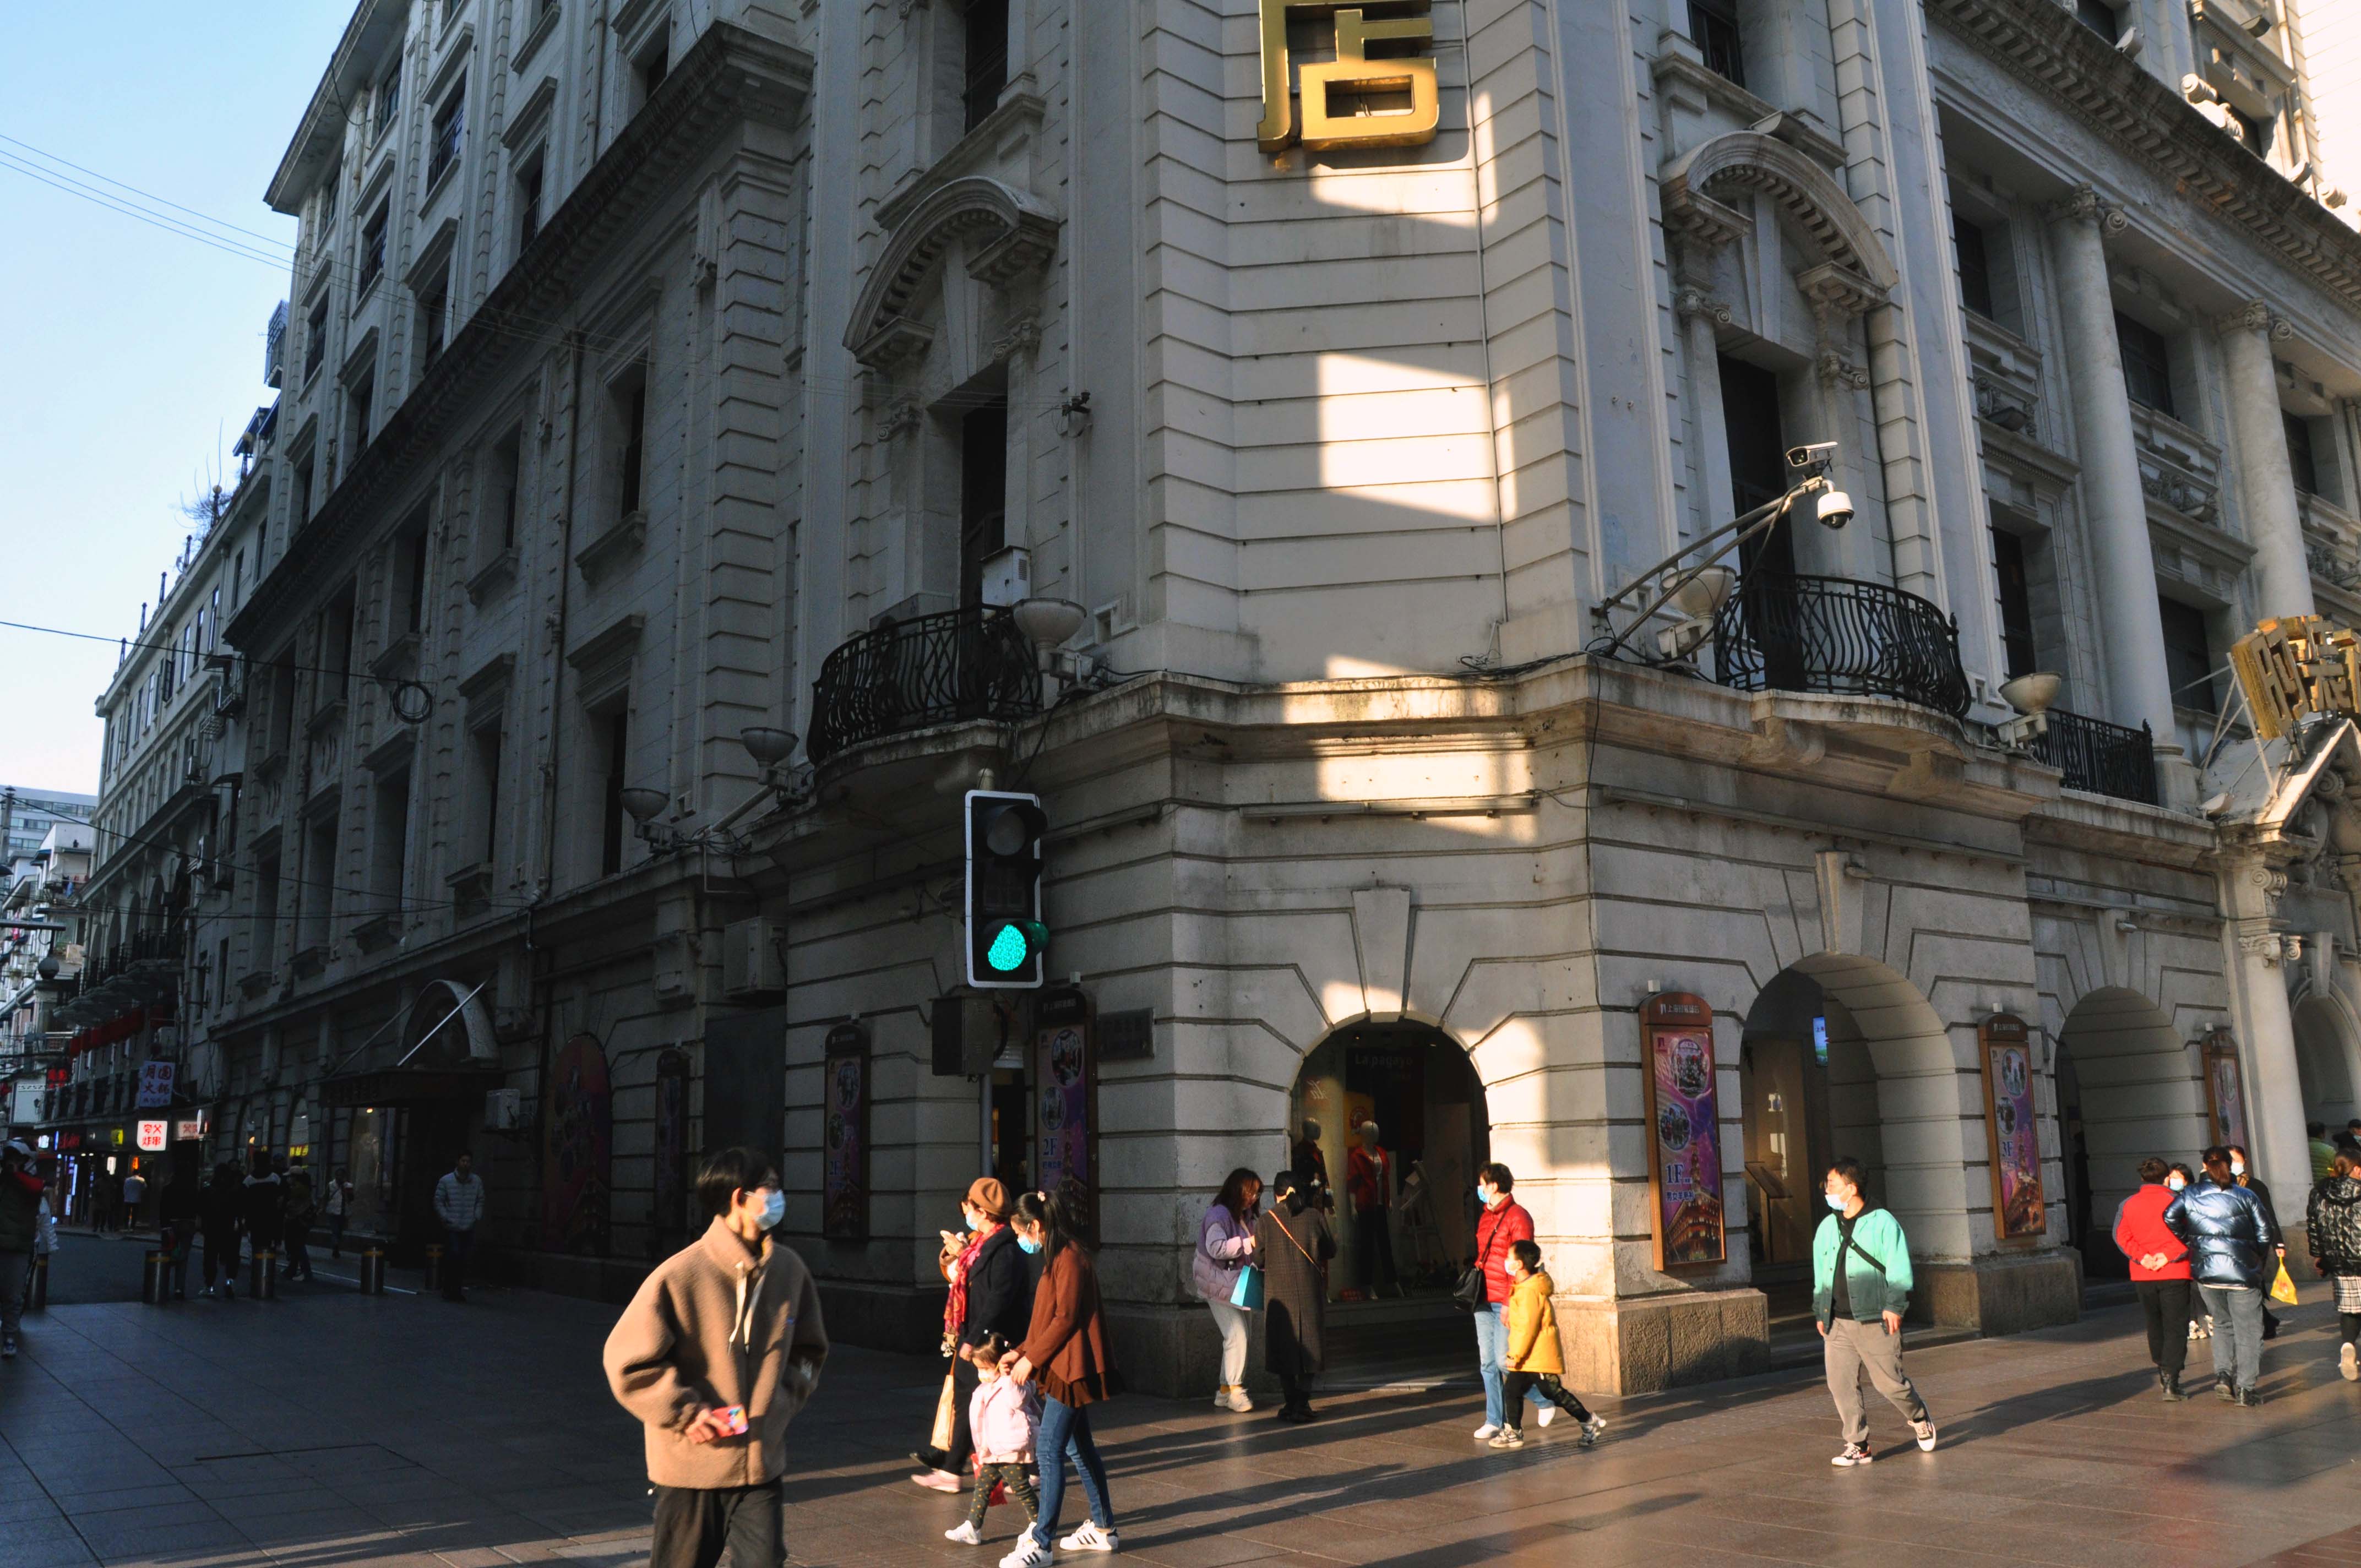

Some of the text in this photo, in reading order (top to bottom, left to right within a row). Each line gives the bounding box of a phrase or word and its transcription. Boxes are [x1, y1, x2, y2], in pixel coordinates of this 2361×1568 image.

[144, 1123, 162, 1134] 夸父
[142, 1136, 161, 1147] 炸串
[1043, 1137, 1058, 1156] 2F
[1666, 1163, 1684, 1184] 1F
